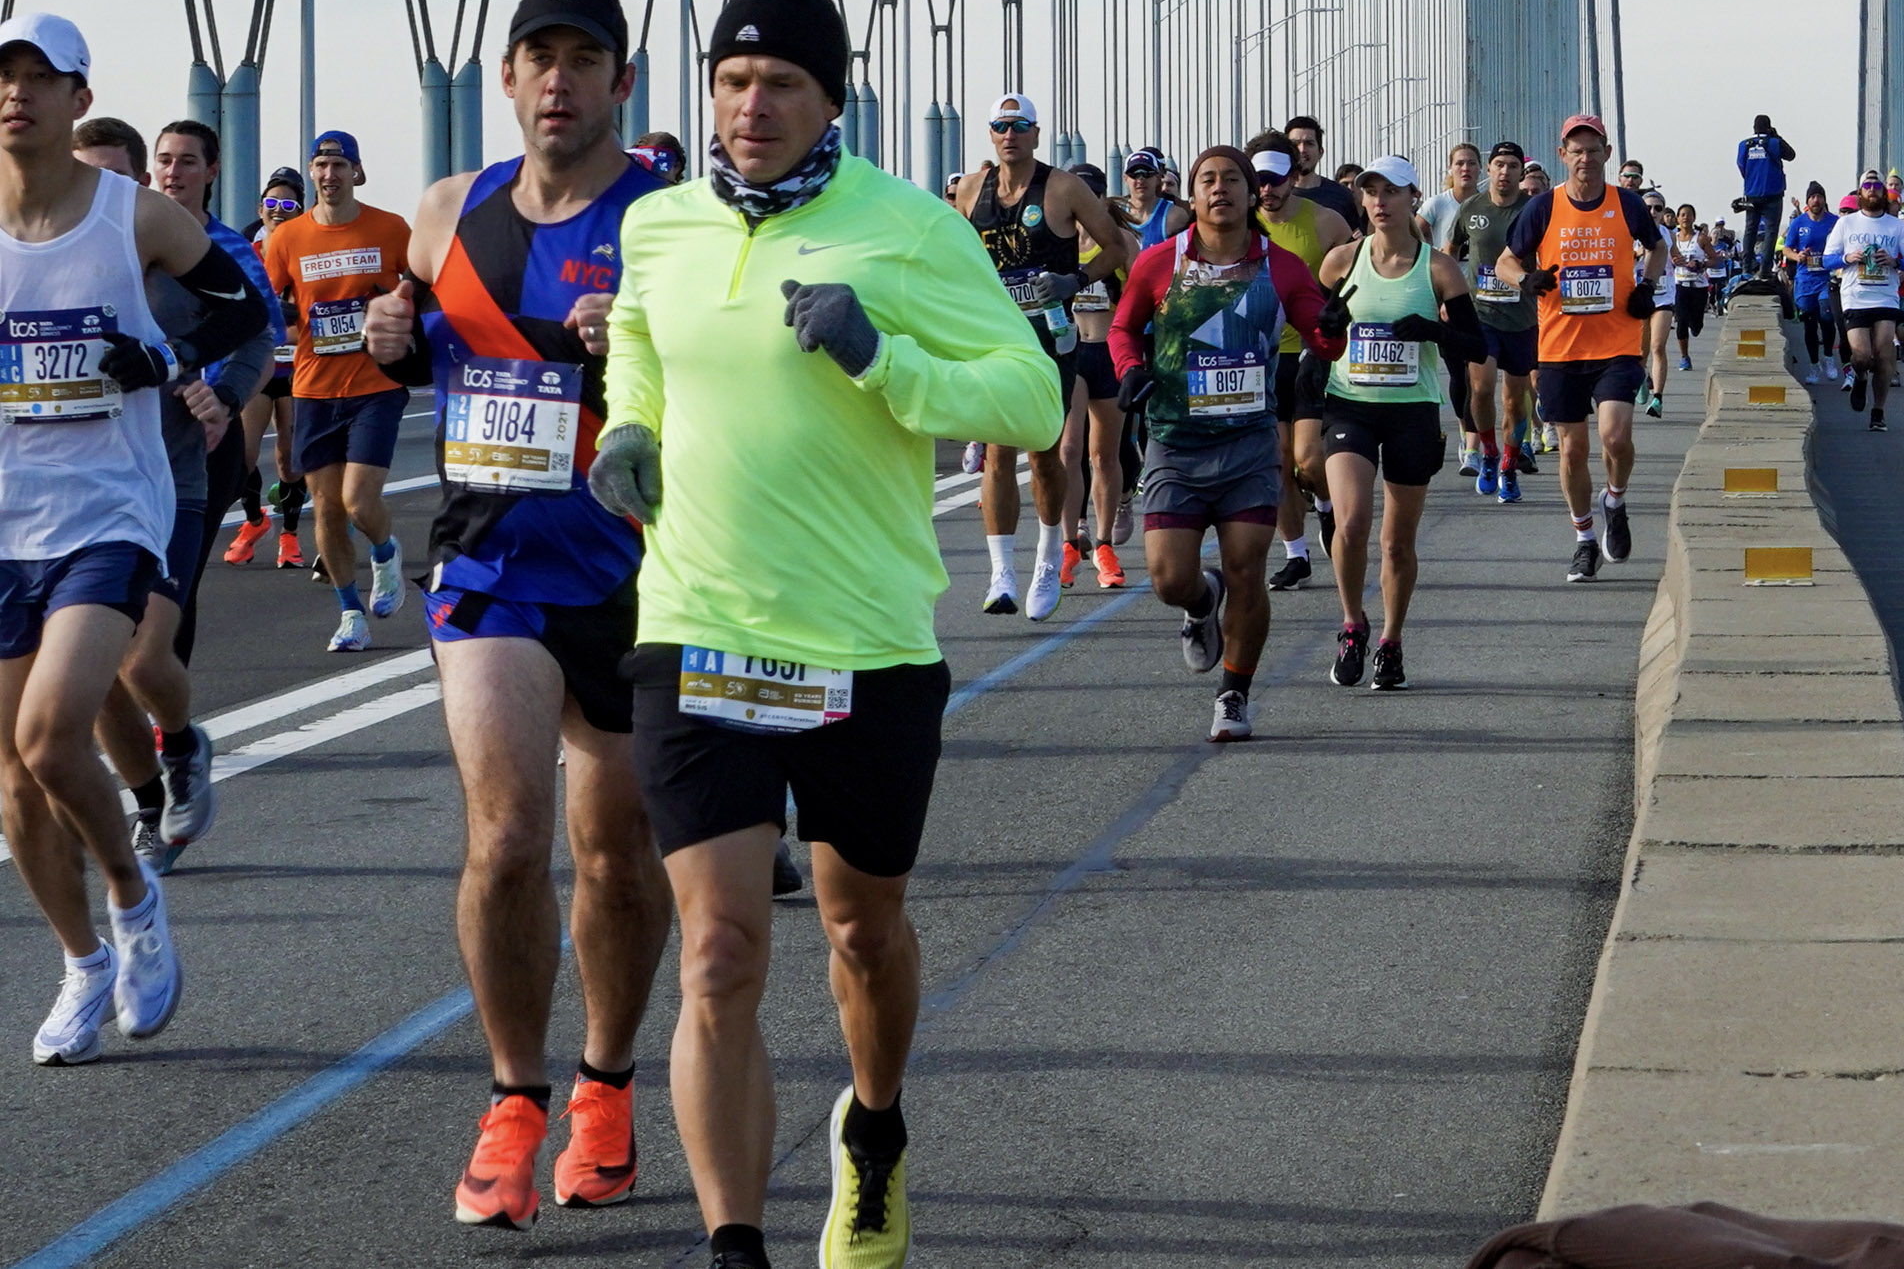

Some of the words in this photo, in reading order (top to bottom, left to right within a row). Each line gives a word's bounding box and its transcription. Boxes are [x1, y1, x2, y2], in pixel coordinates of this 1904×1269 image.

[1560, 227, 1602, 238] EVERY
[1560, 238, 1616, 249] MOTHER
[304, 258, 342, 273] FRED'S
[346, 254, 378, 266] TEAM
[1560, 250, 1614, 262] COUNTS
[560, 258, 612, 289] NYC
[1577, 281, 1602, 297] 8072
[9, 319, 39, 338] tcs
[330, 314, 357, 336] 8154
[1359, 326, 1375, 338] tcs
[35, 343, 89, 380] 3272
[1198, 355, 1217, 367] tcs
[1368, 342, 1405, 363] 10462
[463, 364, 493, 388] tcs
[1216, 370, 1246, 393] 8197
[537, 385, 563, 395] TATA
[482, 399, 537, 444] 9184
[556, 411, 568, 442] 2021
[704, 651, 717, 672] A
